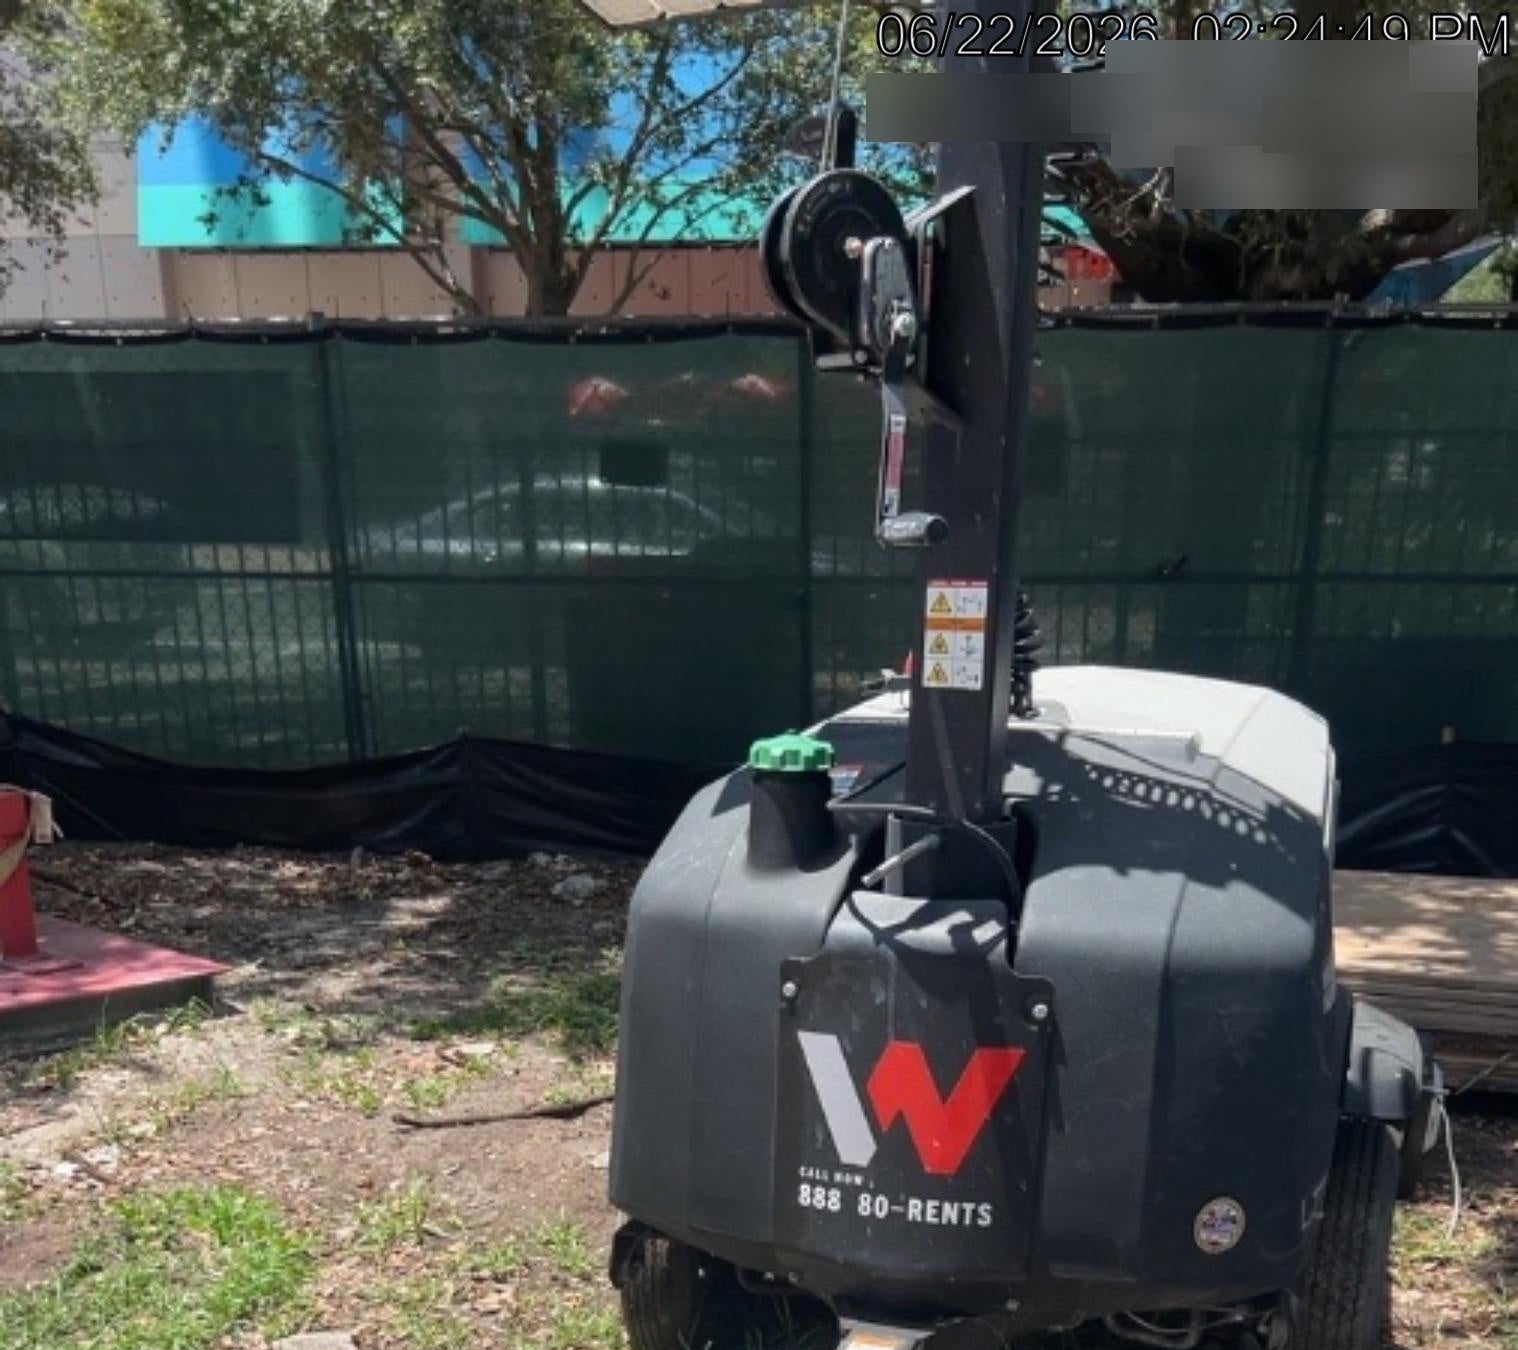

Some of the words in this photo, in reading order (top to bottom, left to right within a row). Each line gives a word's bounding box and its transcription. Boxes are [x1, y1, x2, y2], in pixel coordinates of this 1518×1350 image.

[798, 1166, 829, 1182] CALL
[797, 1183, 842, 1213] 888
[857, 1193, 992, 1227] 80-RENTS
